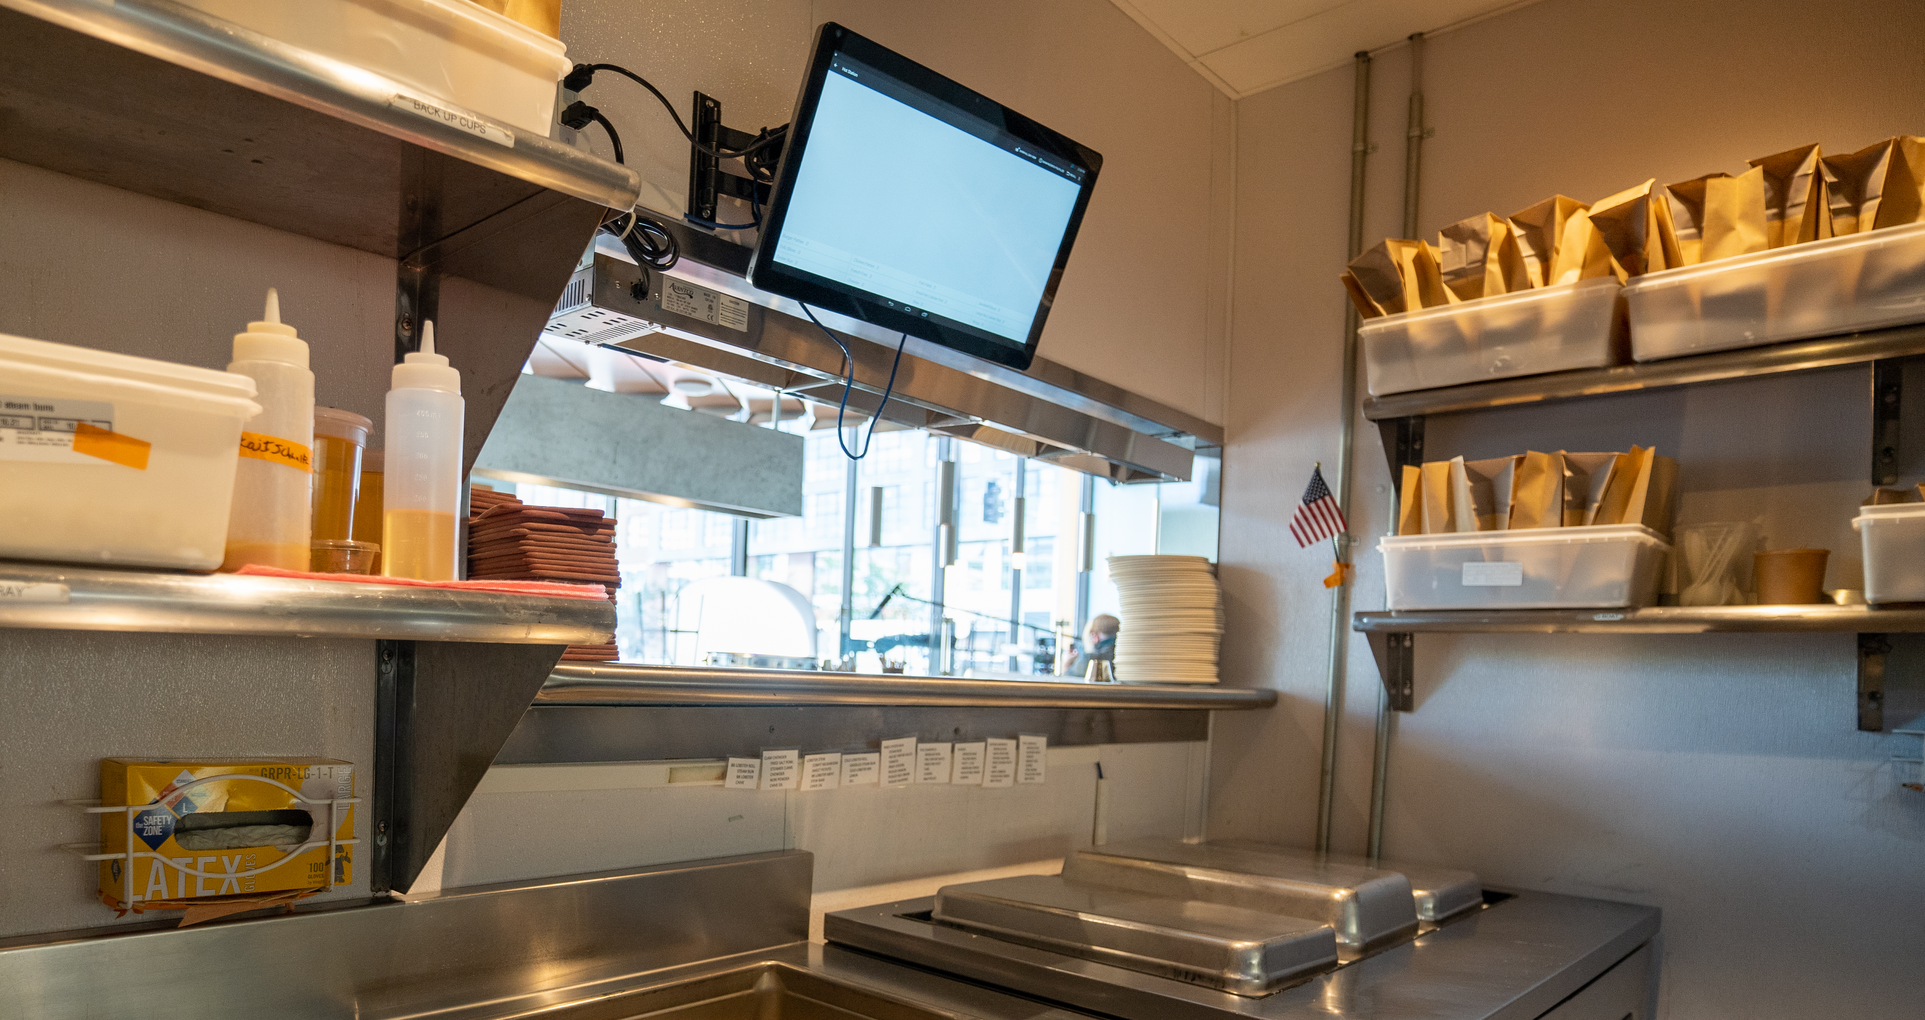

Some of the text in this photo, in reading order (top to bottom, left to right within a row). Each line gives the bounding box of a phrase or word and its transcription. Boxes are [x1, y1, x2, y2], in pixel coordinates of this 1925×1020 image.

[413, 100, 487, 135] BACK UP CUPS
[261, 766, 334, 780] GRPR-LG-1-T
[183, 802, 188, 813] L
[143, 815, 172, 826] SAFETY
[143, 826, 163, 836] ZONE
[309, 862, 324, 873] 100
